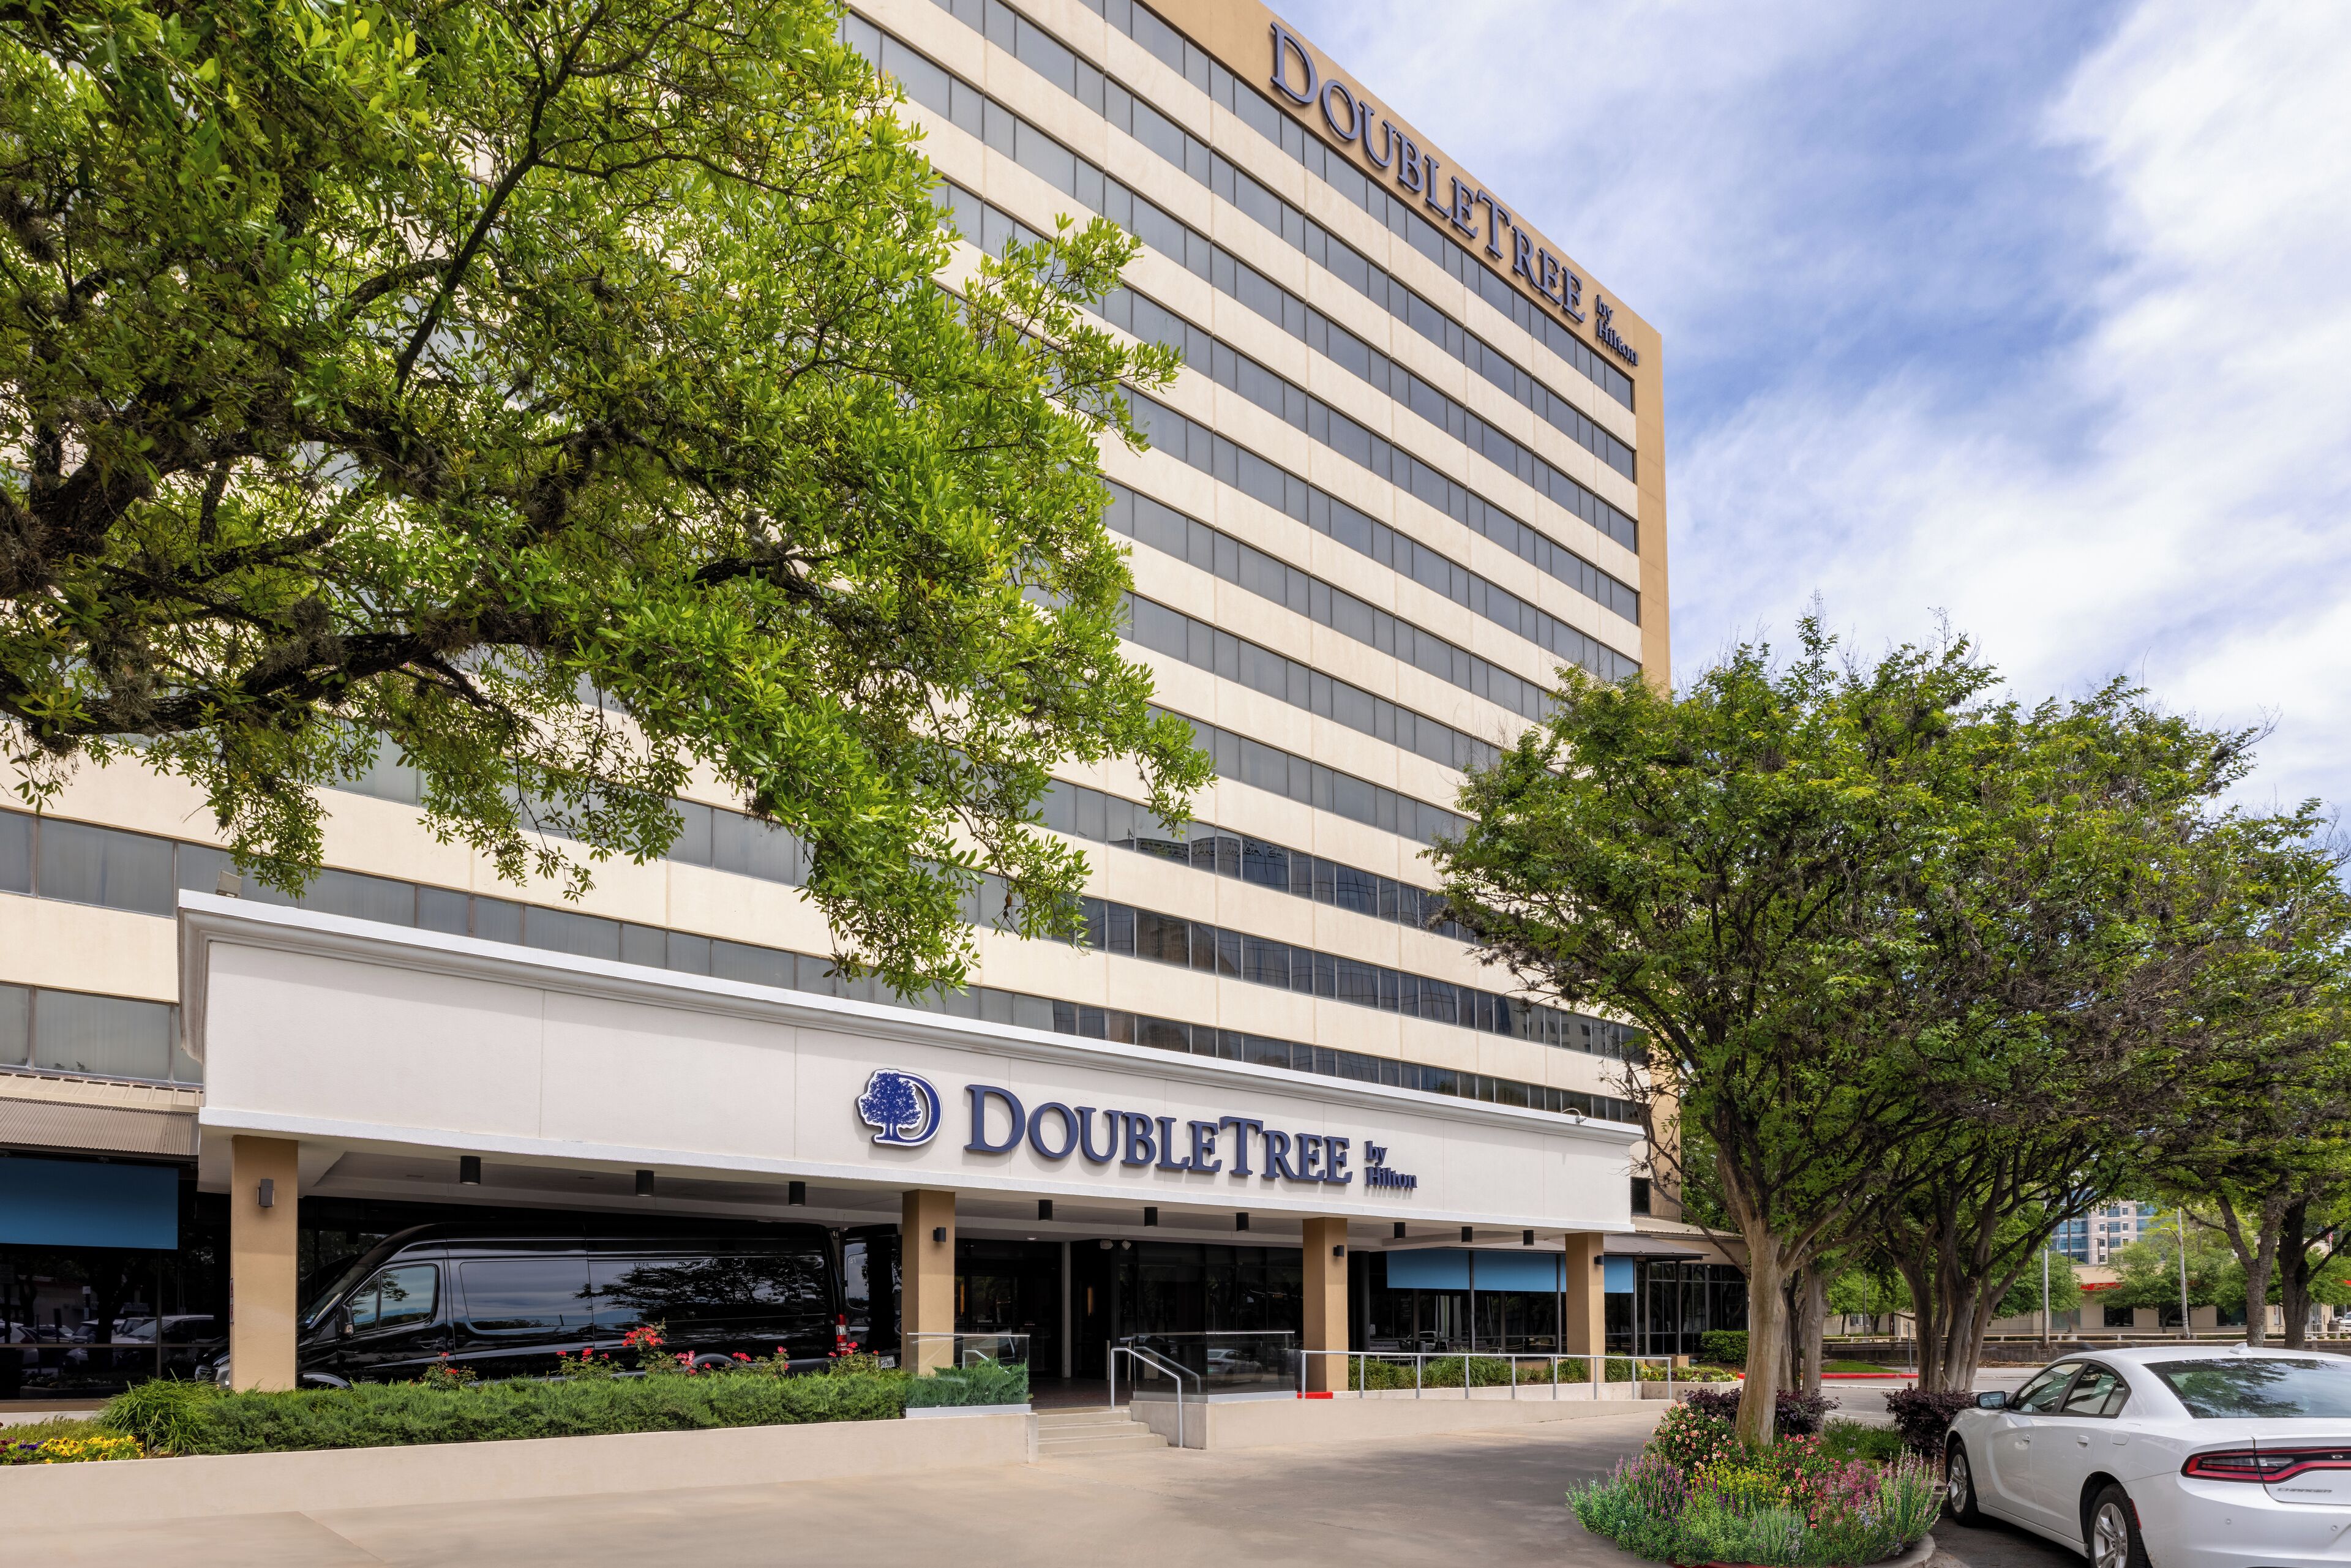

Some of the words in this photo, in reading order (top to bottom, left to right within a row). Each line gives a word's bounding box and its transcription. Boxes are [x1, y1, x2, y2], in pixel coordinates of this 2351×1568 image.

[1270, 21, 1586, 324] DOUBLETREE
[1595, 294, 1614, 324] by
[1596, 318, 1638, 366] Hilton
[964, 1084, 1353, 1184] DOUBLETREE
[1364, 1141, 1388, 1167] by
[1364, 1166, 1418, 1188] Hilton
